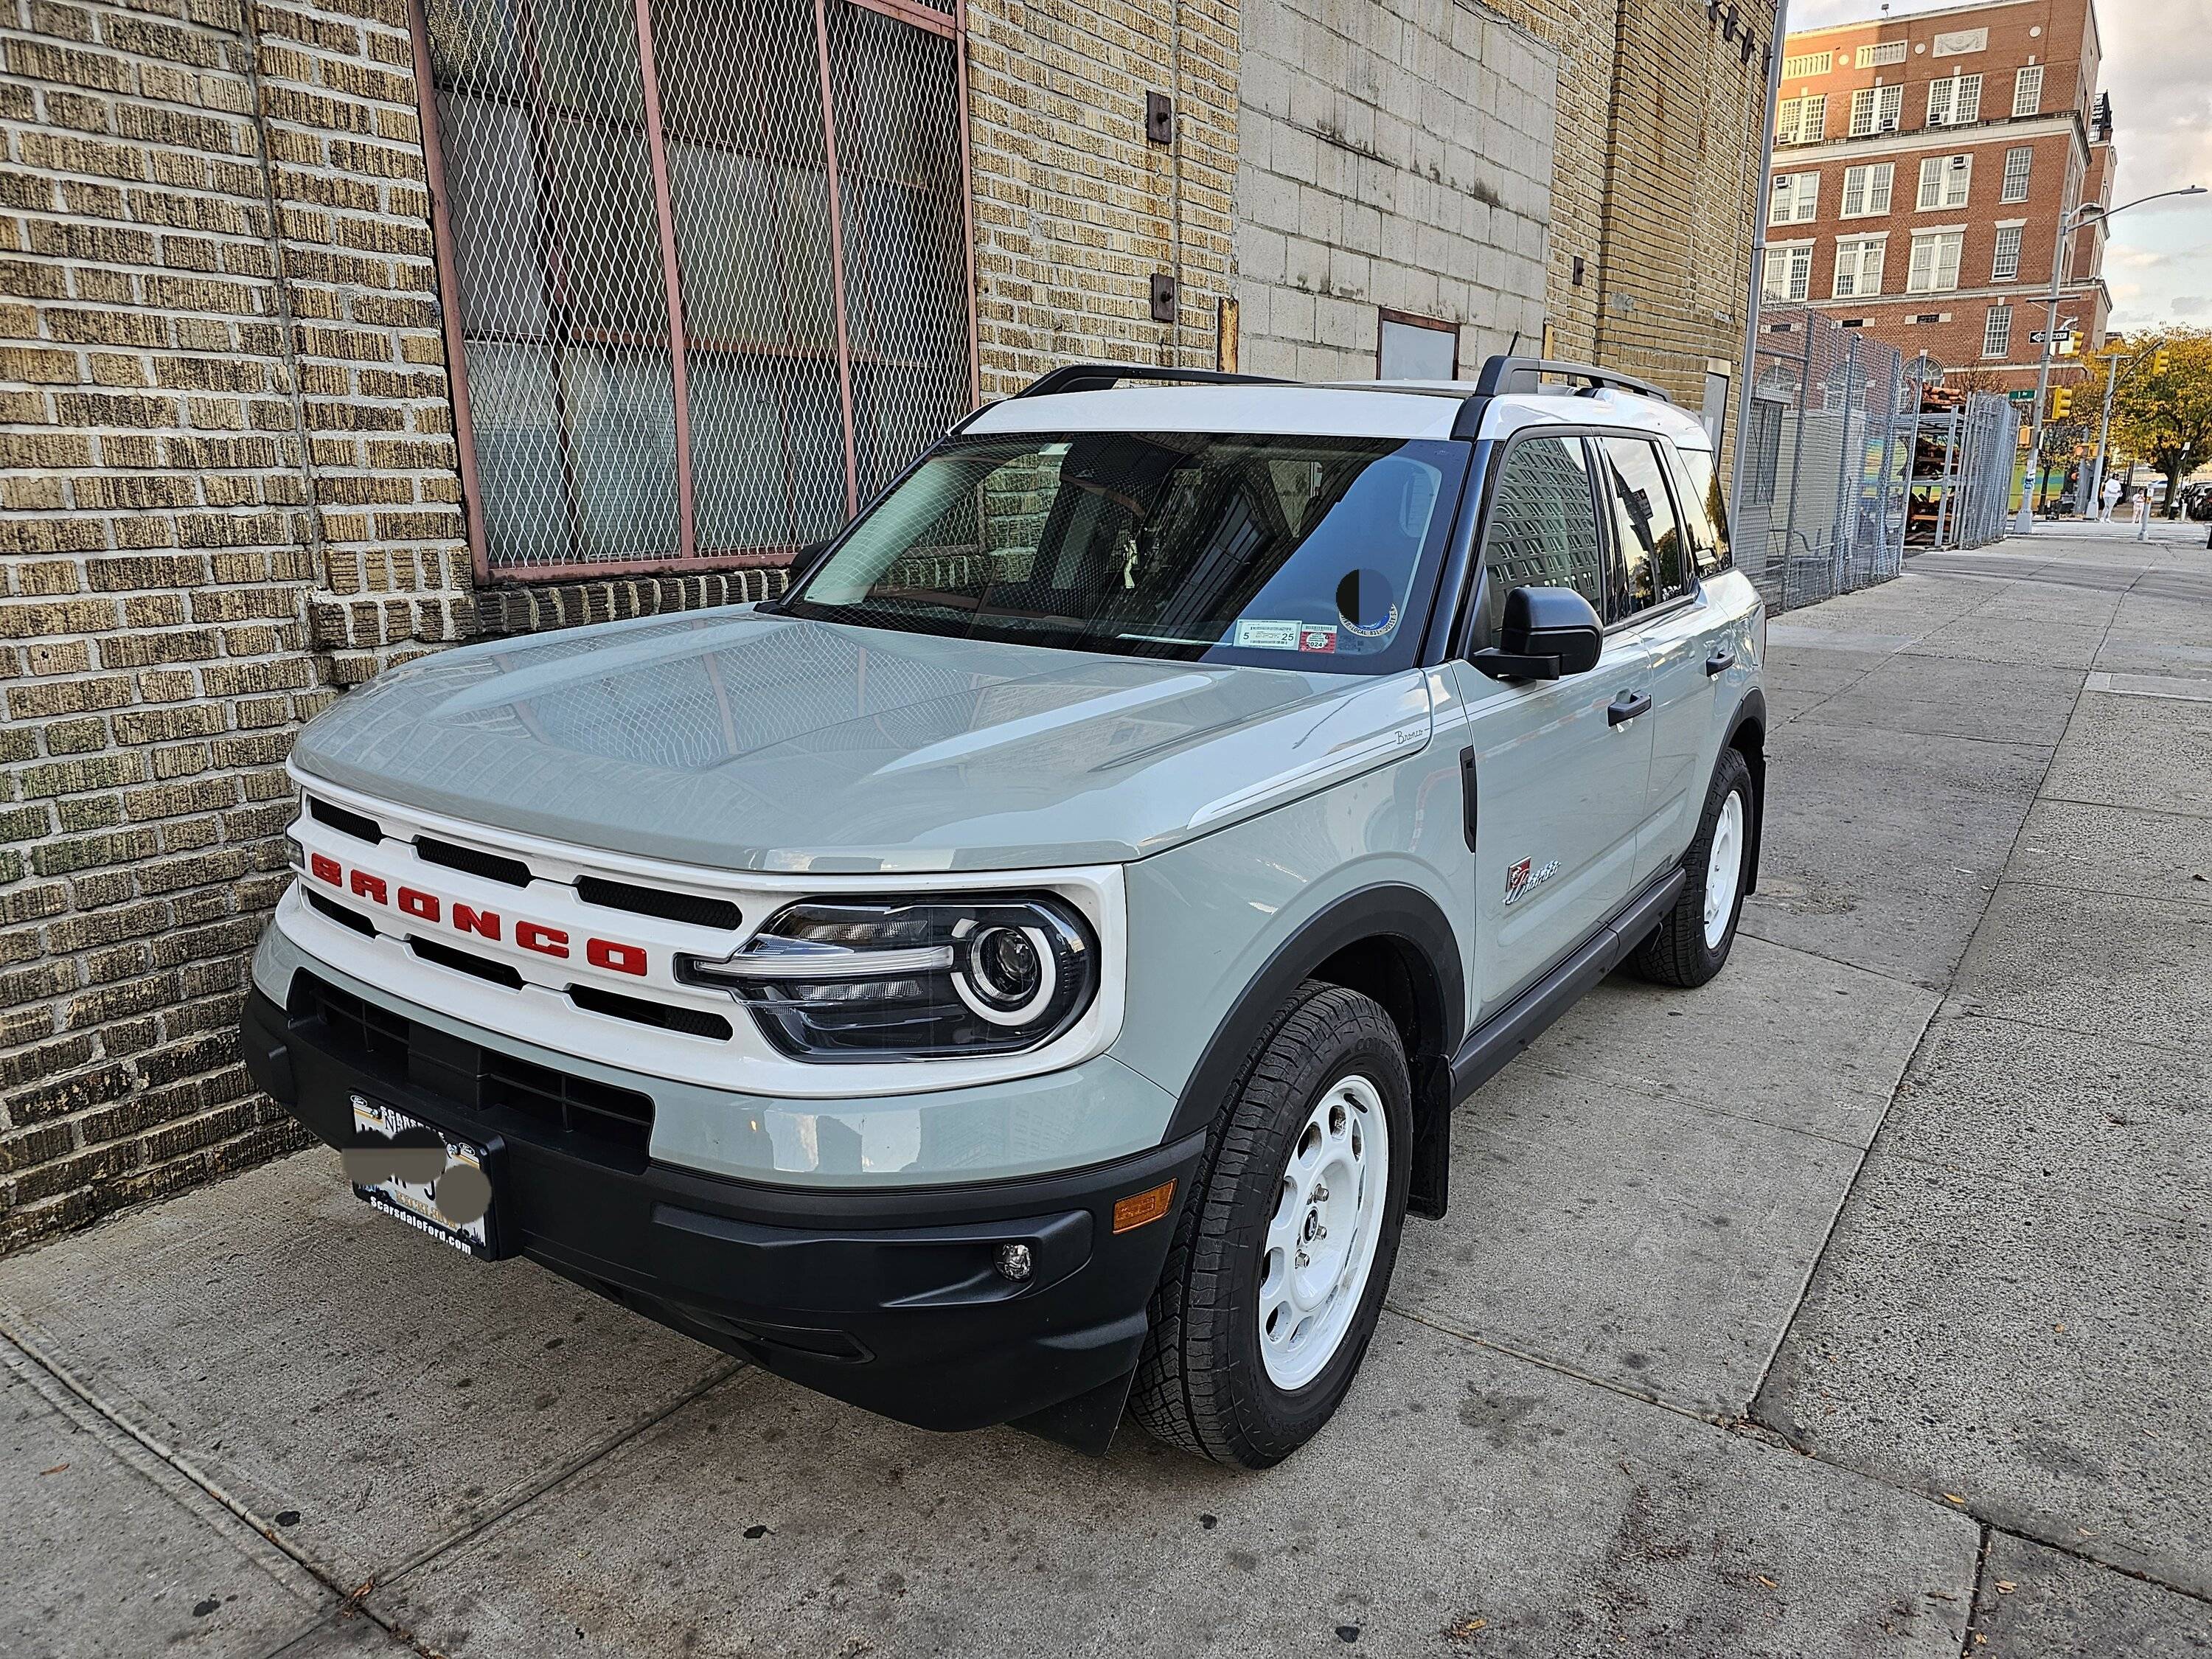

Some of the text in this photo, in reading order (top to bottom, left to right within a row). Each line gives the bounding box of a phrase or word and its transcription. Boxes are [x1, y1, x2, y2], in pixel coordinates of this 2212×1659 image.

[1243, 632, 1250, 640] 5
[1281, 633, 1294, 641] 25
[1351, 627, 1366, 635] LOCAL
[1394, 730, 1423, 745] Bronco
[311, 852, 647, 977] BRONCO
[370, 1196, 471, 1254] ScarsdaleFord.com
